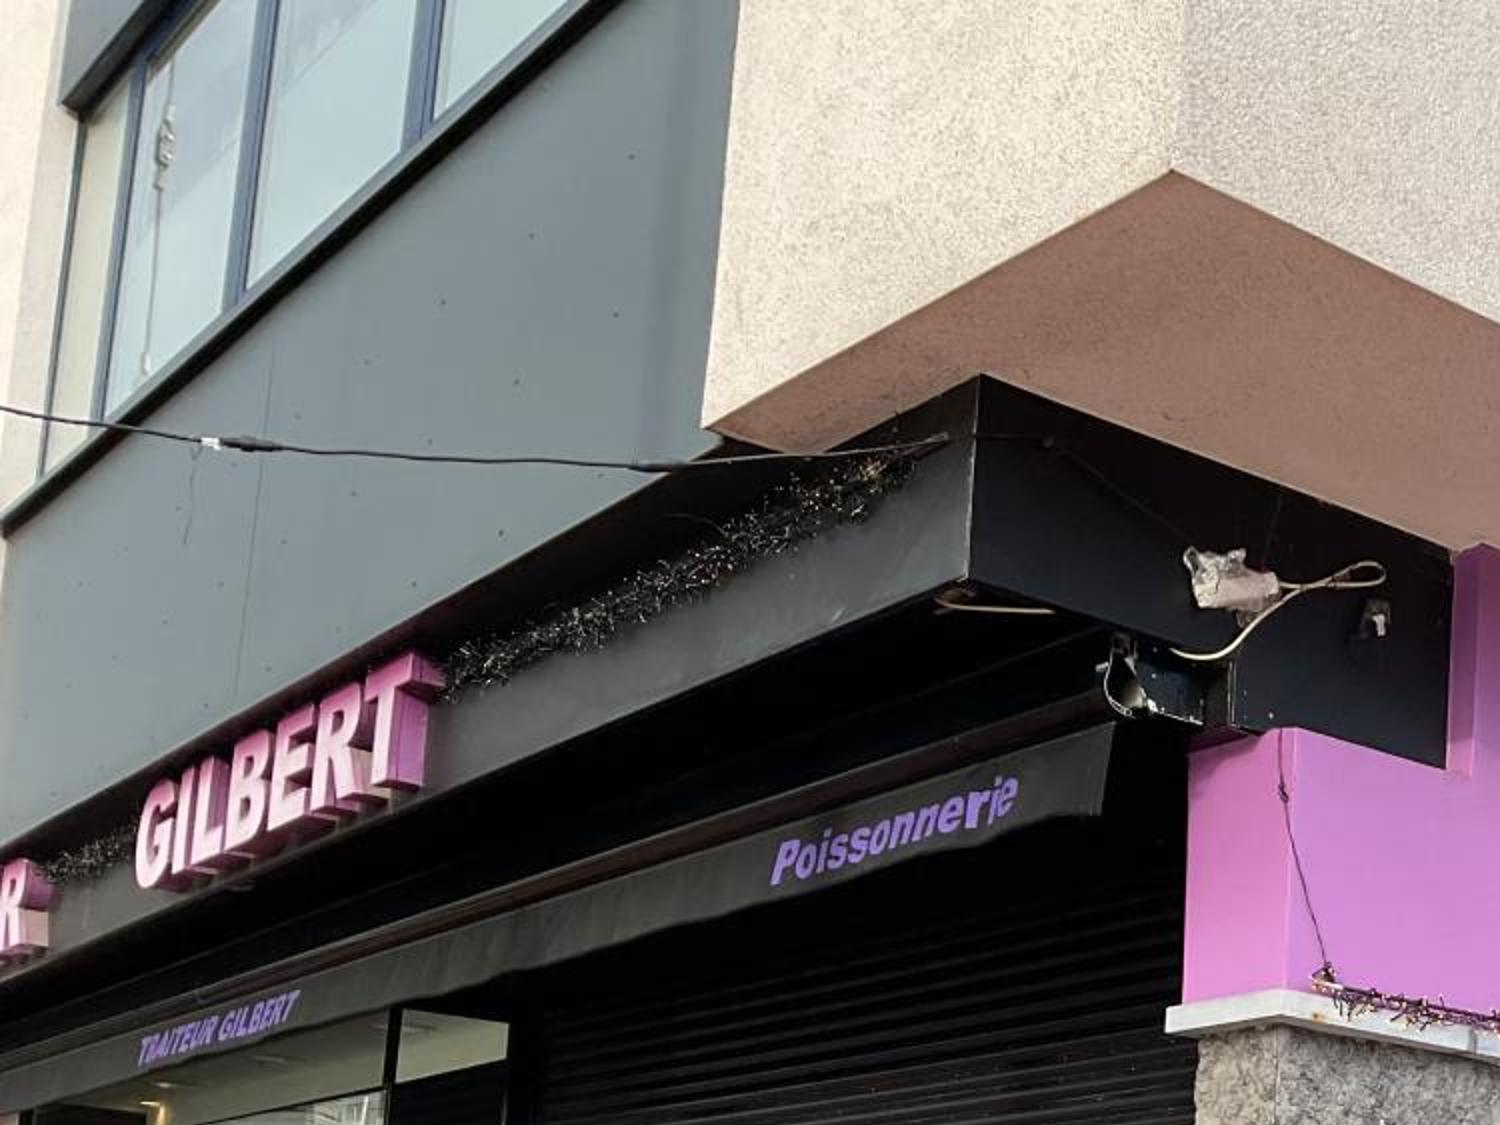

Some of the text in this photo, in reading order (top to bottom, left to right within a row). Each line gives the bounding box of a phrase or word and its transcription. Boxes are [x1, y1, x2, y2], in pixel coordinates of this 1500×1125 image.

[135, 652, 440, 890] GILBERT
[769, 775, 1019, 886] Poissonnerie
[137, 989, 302, 1067] TRAITEUR GILBERT
